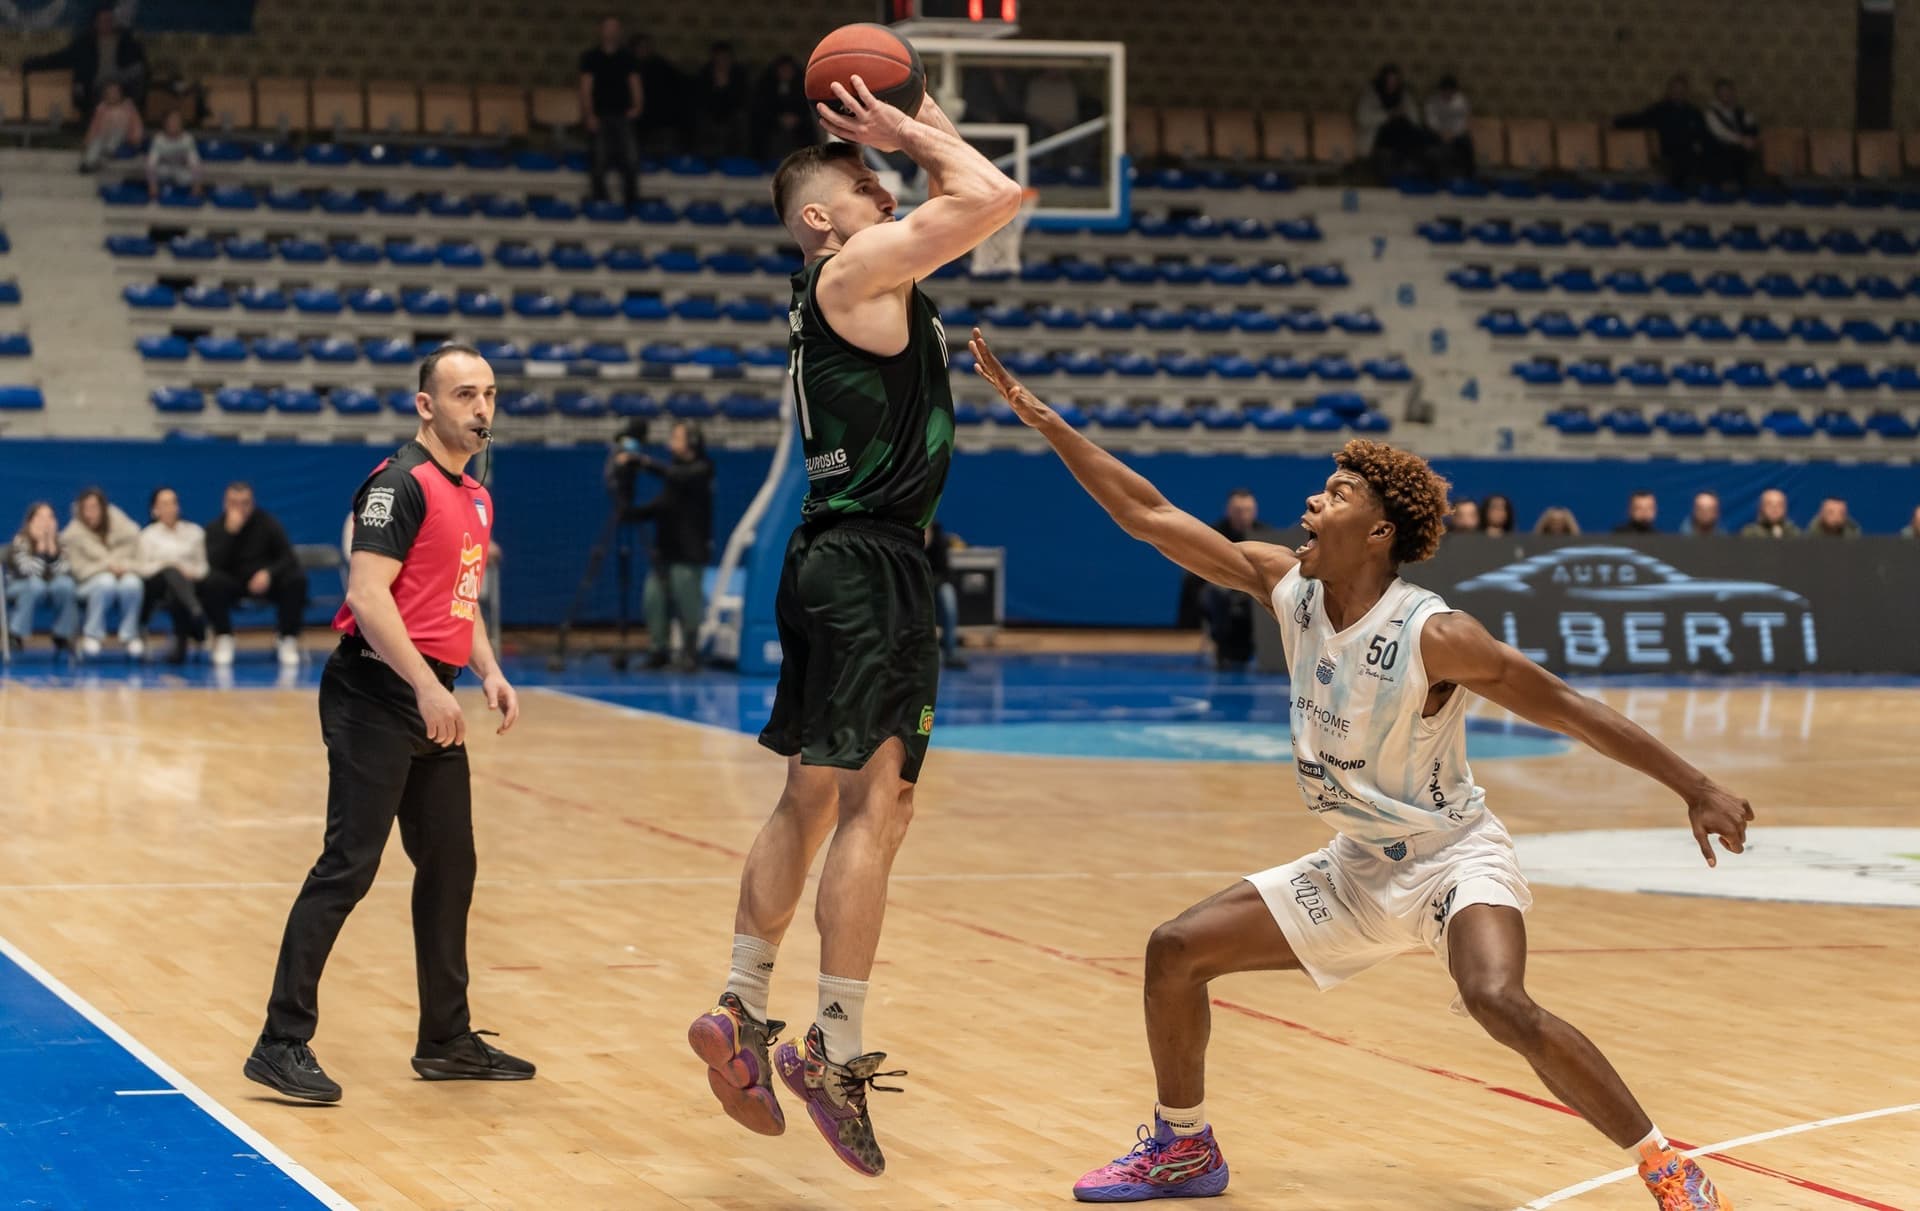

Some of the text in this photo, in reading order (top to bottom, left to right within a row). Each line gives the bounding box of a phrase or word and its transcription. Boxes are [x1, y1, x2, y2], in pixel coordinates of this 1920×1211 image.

[1460, 378, 1479, 402] 4
[1551, 564, 1638, 583] AUTO
[1366, 634, 1399, 671] 50
[1503, 611, 1819, 667] LBERTI
[1318, 750, 1366, 771] AIRKOND
[1290, 872, 1334, 926] vipa
